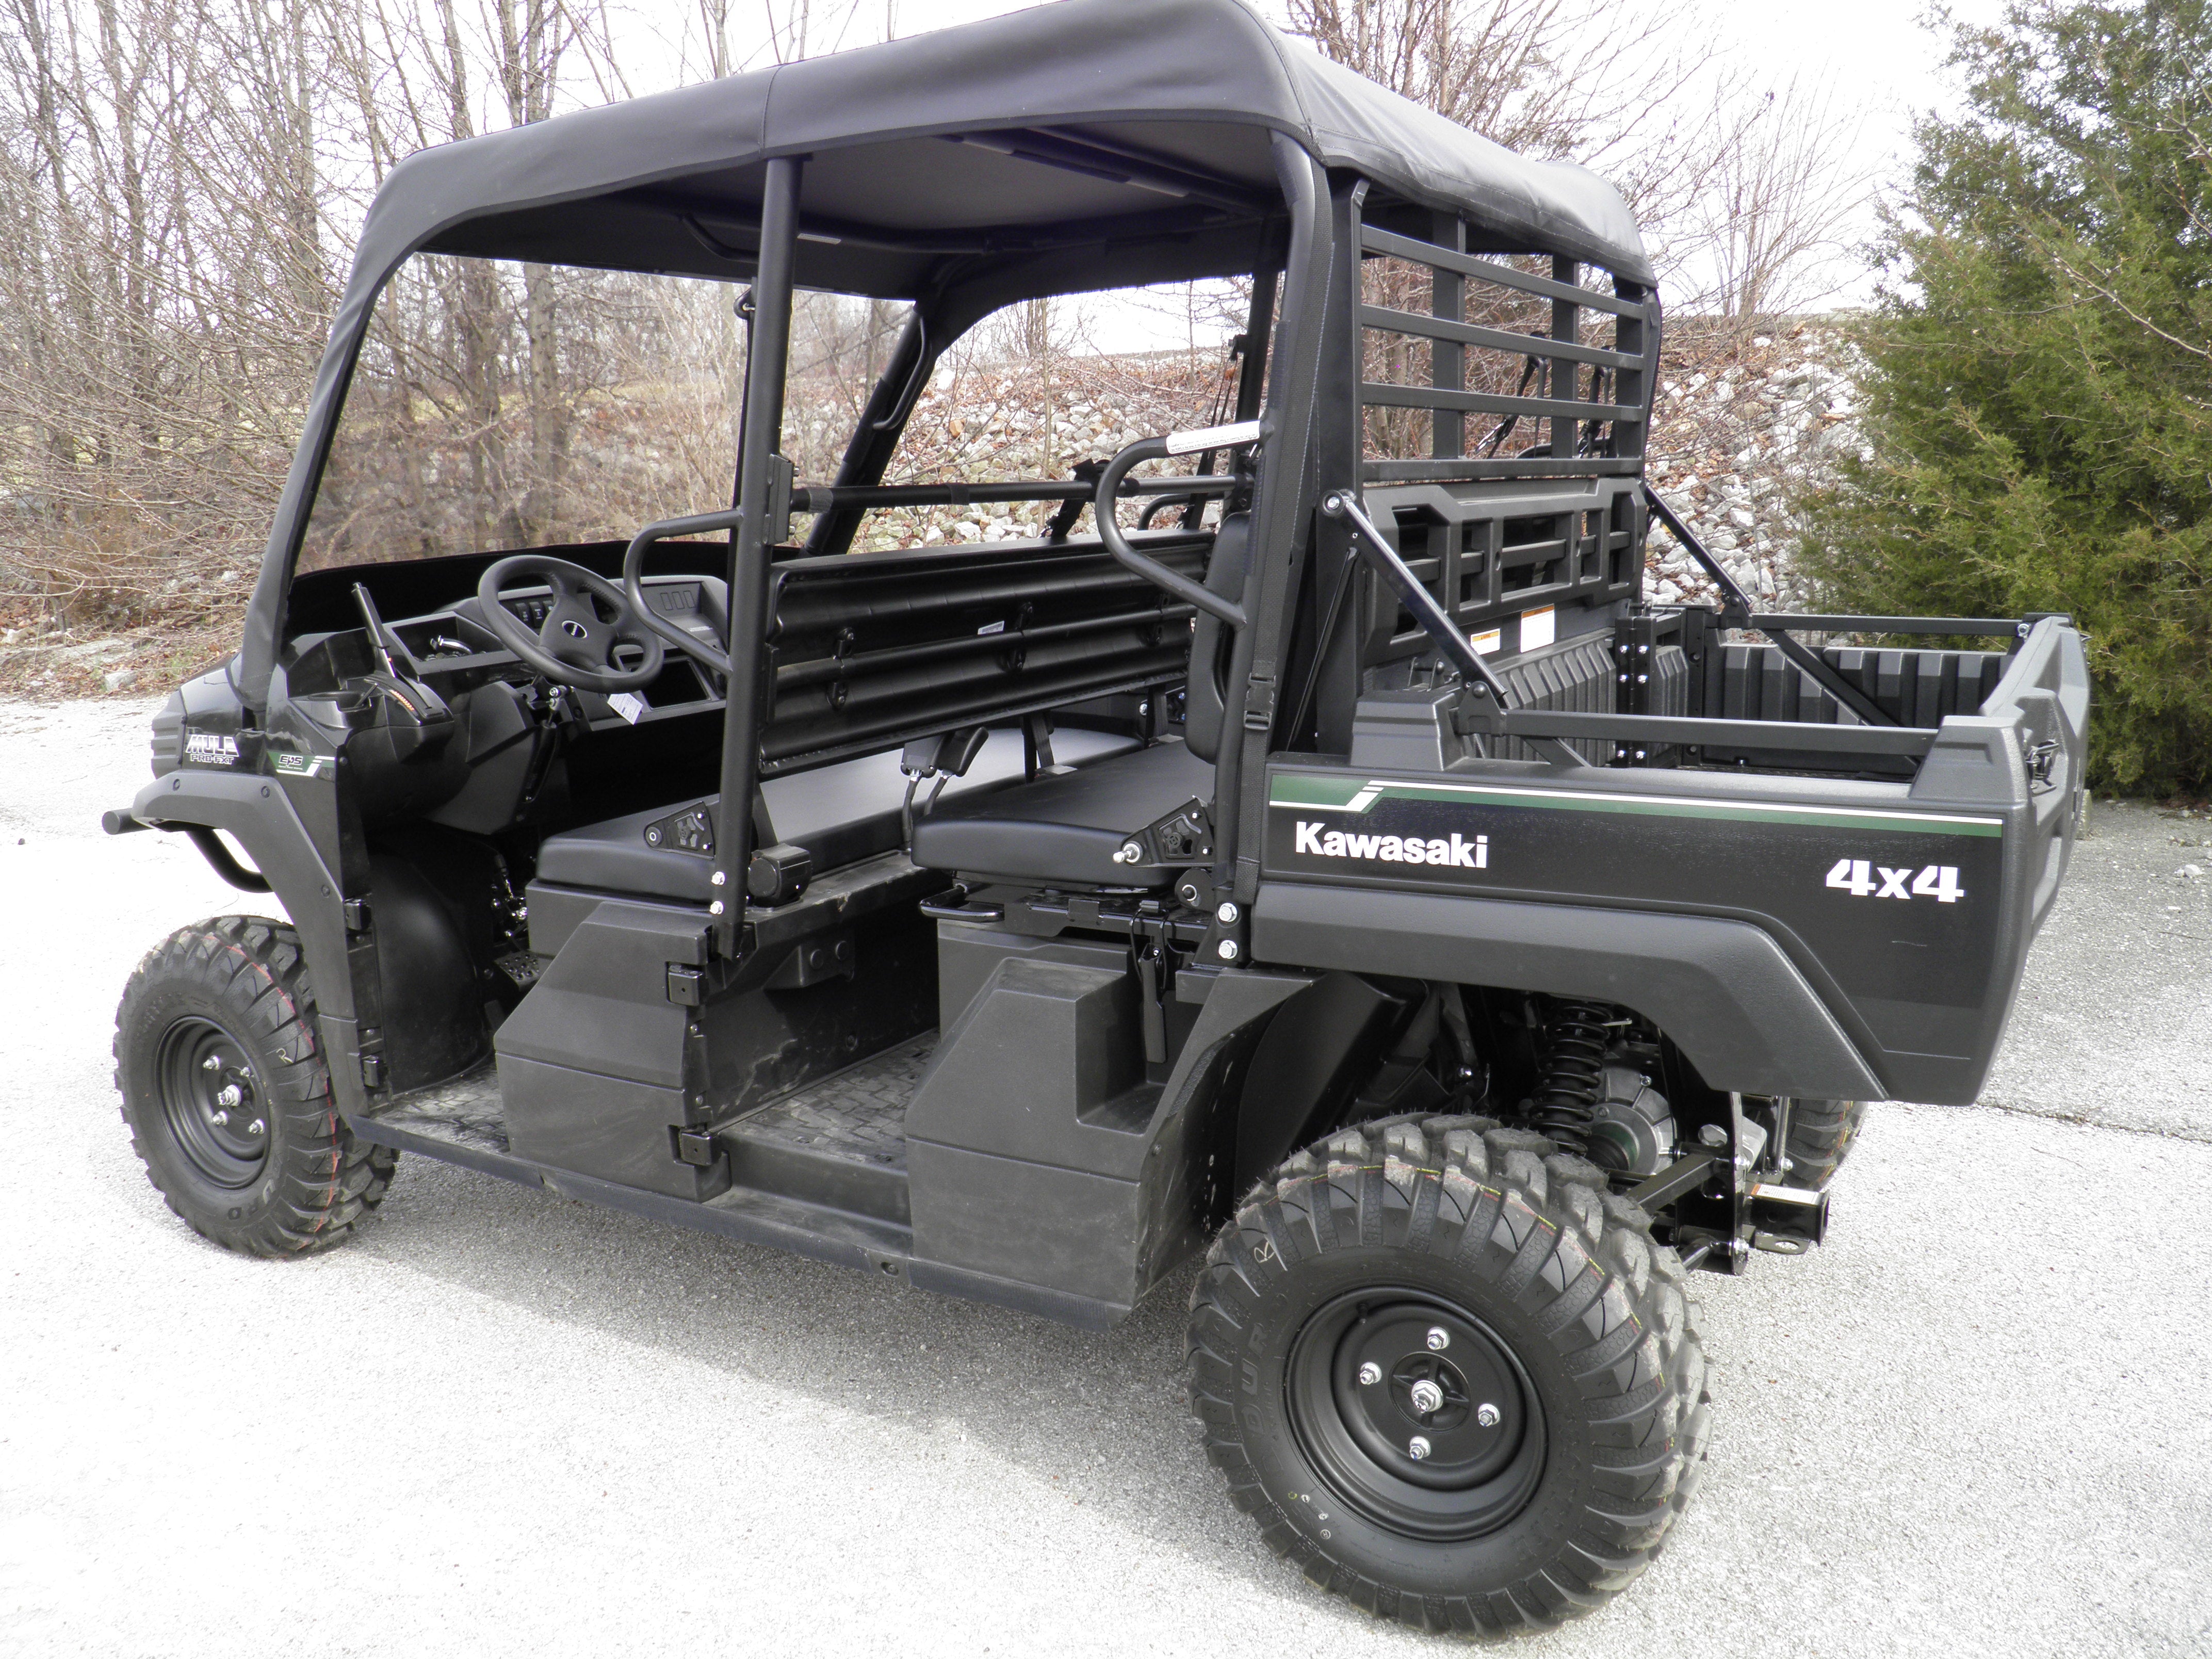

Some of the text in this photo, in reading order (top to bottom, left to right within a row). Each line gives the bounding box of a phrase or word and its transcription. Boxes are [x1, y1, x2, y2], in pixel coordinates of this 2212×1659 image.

[185, 734, 239, 757] MULE
[190, 753, 234, 765] PRO-FXT
[1296, 821, 1488, 868] Kawasaki
[1826, 859, 1965, 903] 4x4
